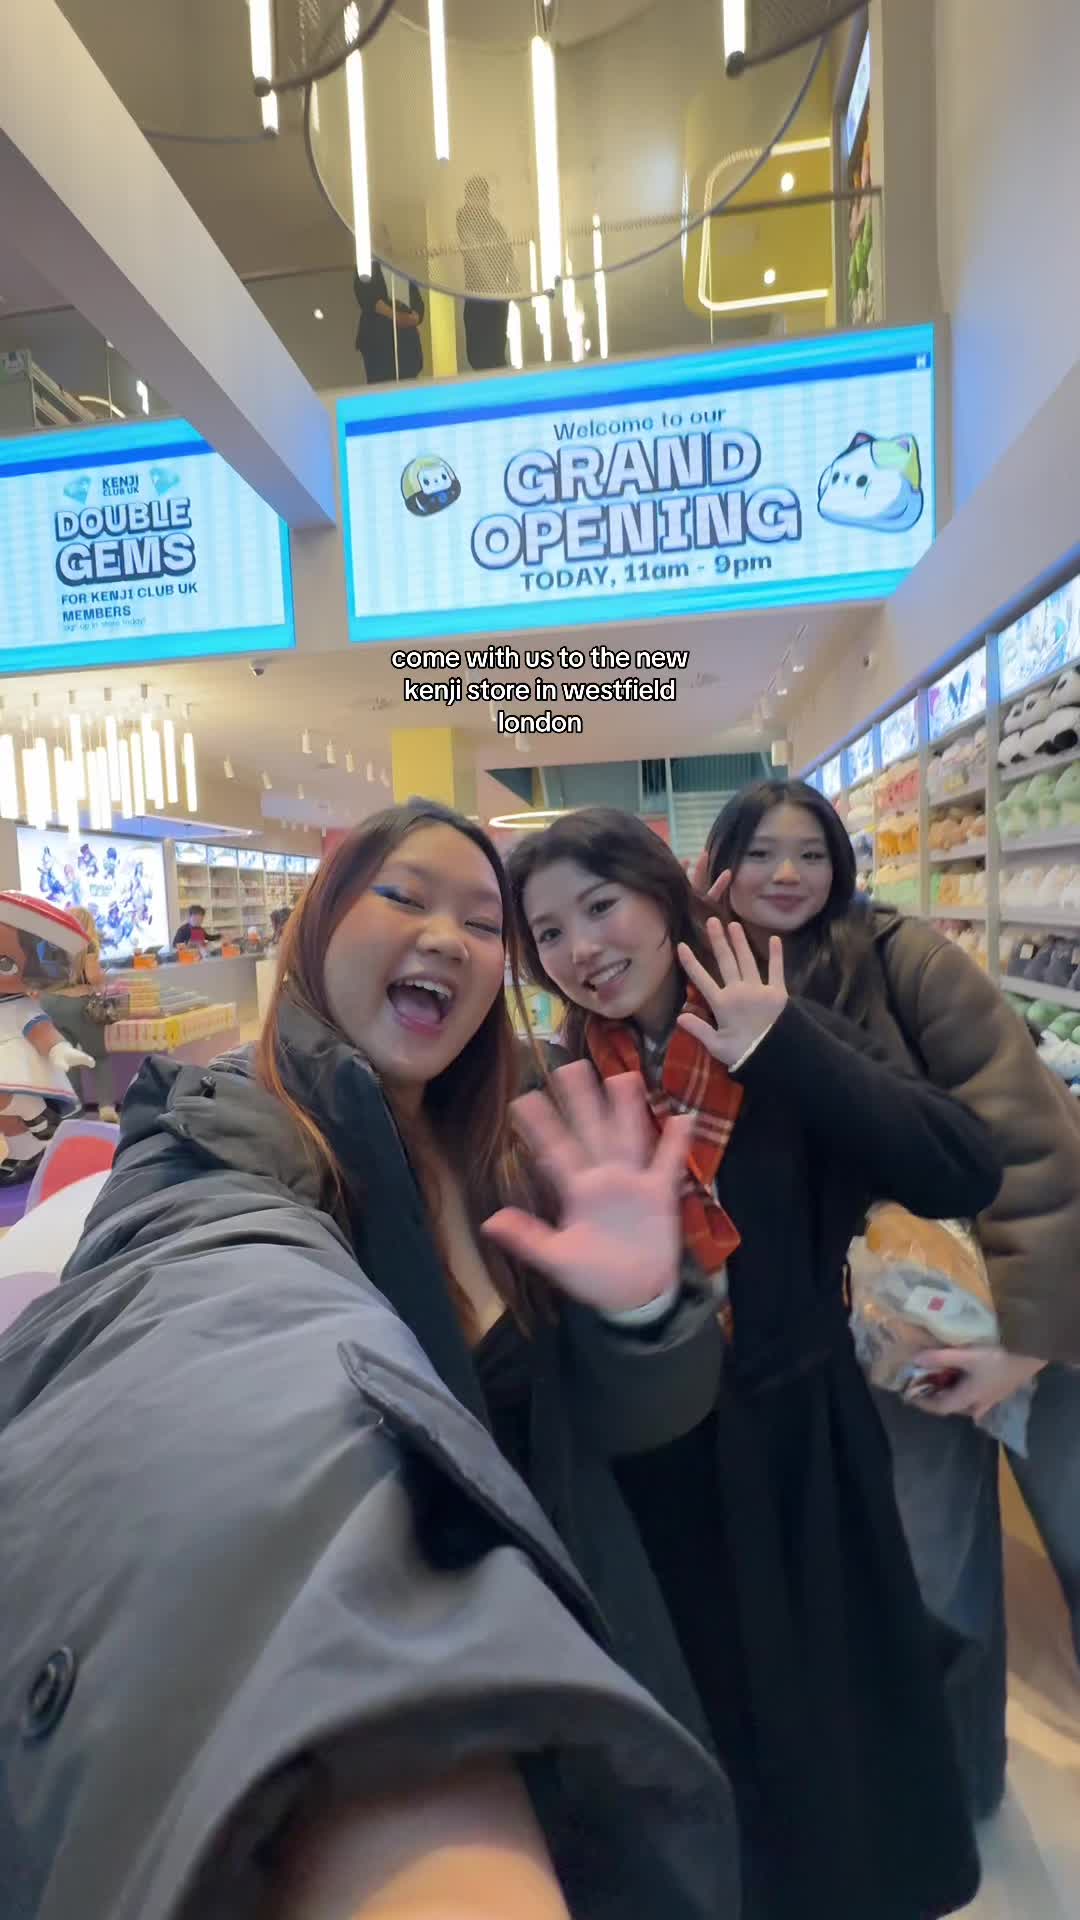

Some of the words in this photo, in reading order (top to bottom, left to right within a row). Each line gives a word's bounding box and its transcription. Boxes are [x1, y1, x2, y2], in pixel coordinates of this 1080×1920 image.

[553, 416, 653, 441] Welcome
[662, 411, 682, 427] to
[690, 408, 727, 424] our
[102, 475, 139, 488] KENJI
[504, 428, 762, 507] GRAND
[103, 488, 125, 496] CLUB
[55, 498, 192, 541] DOUBLE
[470, 486, 802, 570] OPENING
[56, 533, 196, 587] GEMS
[520, 566, 617, 592] TODAY,
[624, 560, 689, 583] 11am
[714, 553, 772, 579] 9pm
[61, 593, 87, 605] FOR
[91, 589, 133, 603] KENJI
[137, 584, 174, 598] CLUB
[178, 582, 198, 594] UK
[62, 605, 131, 622] MEMBERS
